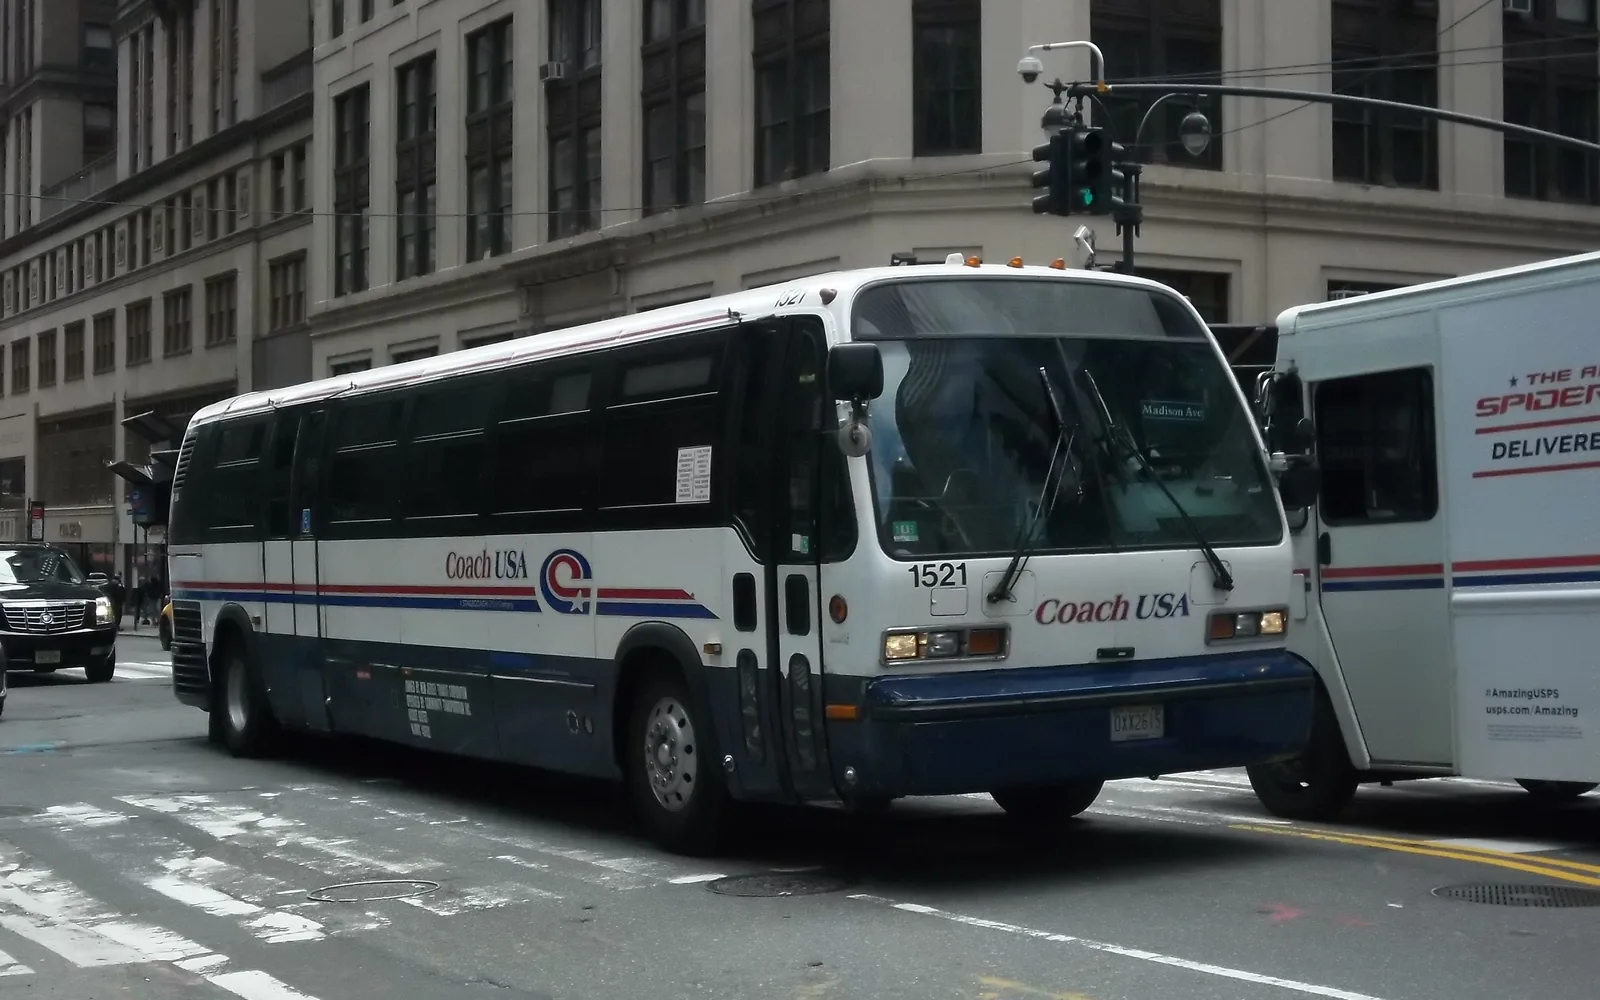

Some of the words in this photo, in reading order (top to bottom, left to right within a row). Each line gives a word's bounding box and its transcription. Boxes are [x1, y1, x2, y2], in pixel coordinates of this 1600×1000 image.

[1526, 369, 1572, 386] THE
[1580, 365, 1600, 379] A
[1142, 404, 1184, 417] Madison
[446, 546, 491, 579] Coach
[495, 550, 528, 579] USA
[908, 562, 967, 588] 1521
[1035, 594, 1130, 625] Coach
[1135, 592, 1190, 620] USA
[1485, 688, 1560, 700] #AmazingUSPS
[1486, 705, 1578, 718] usps.com/Amazing
